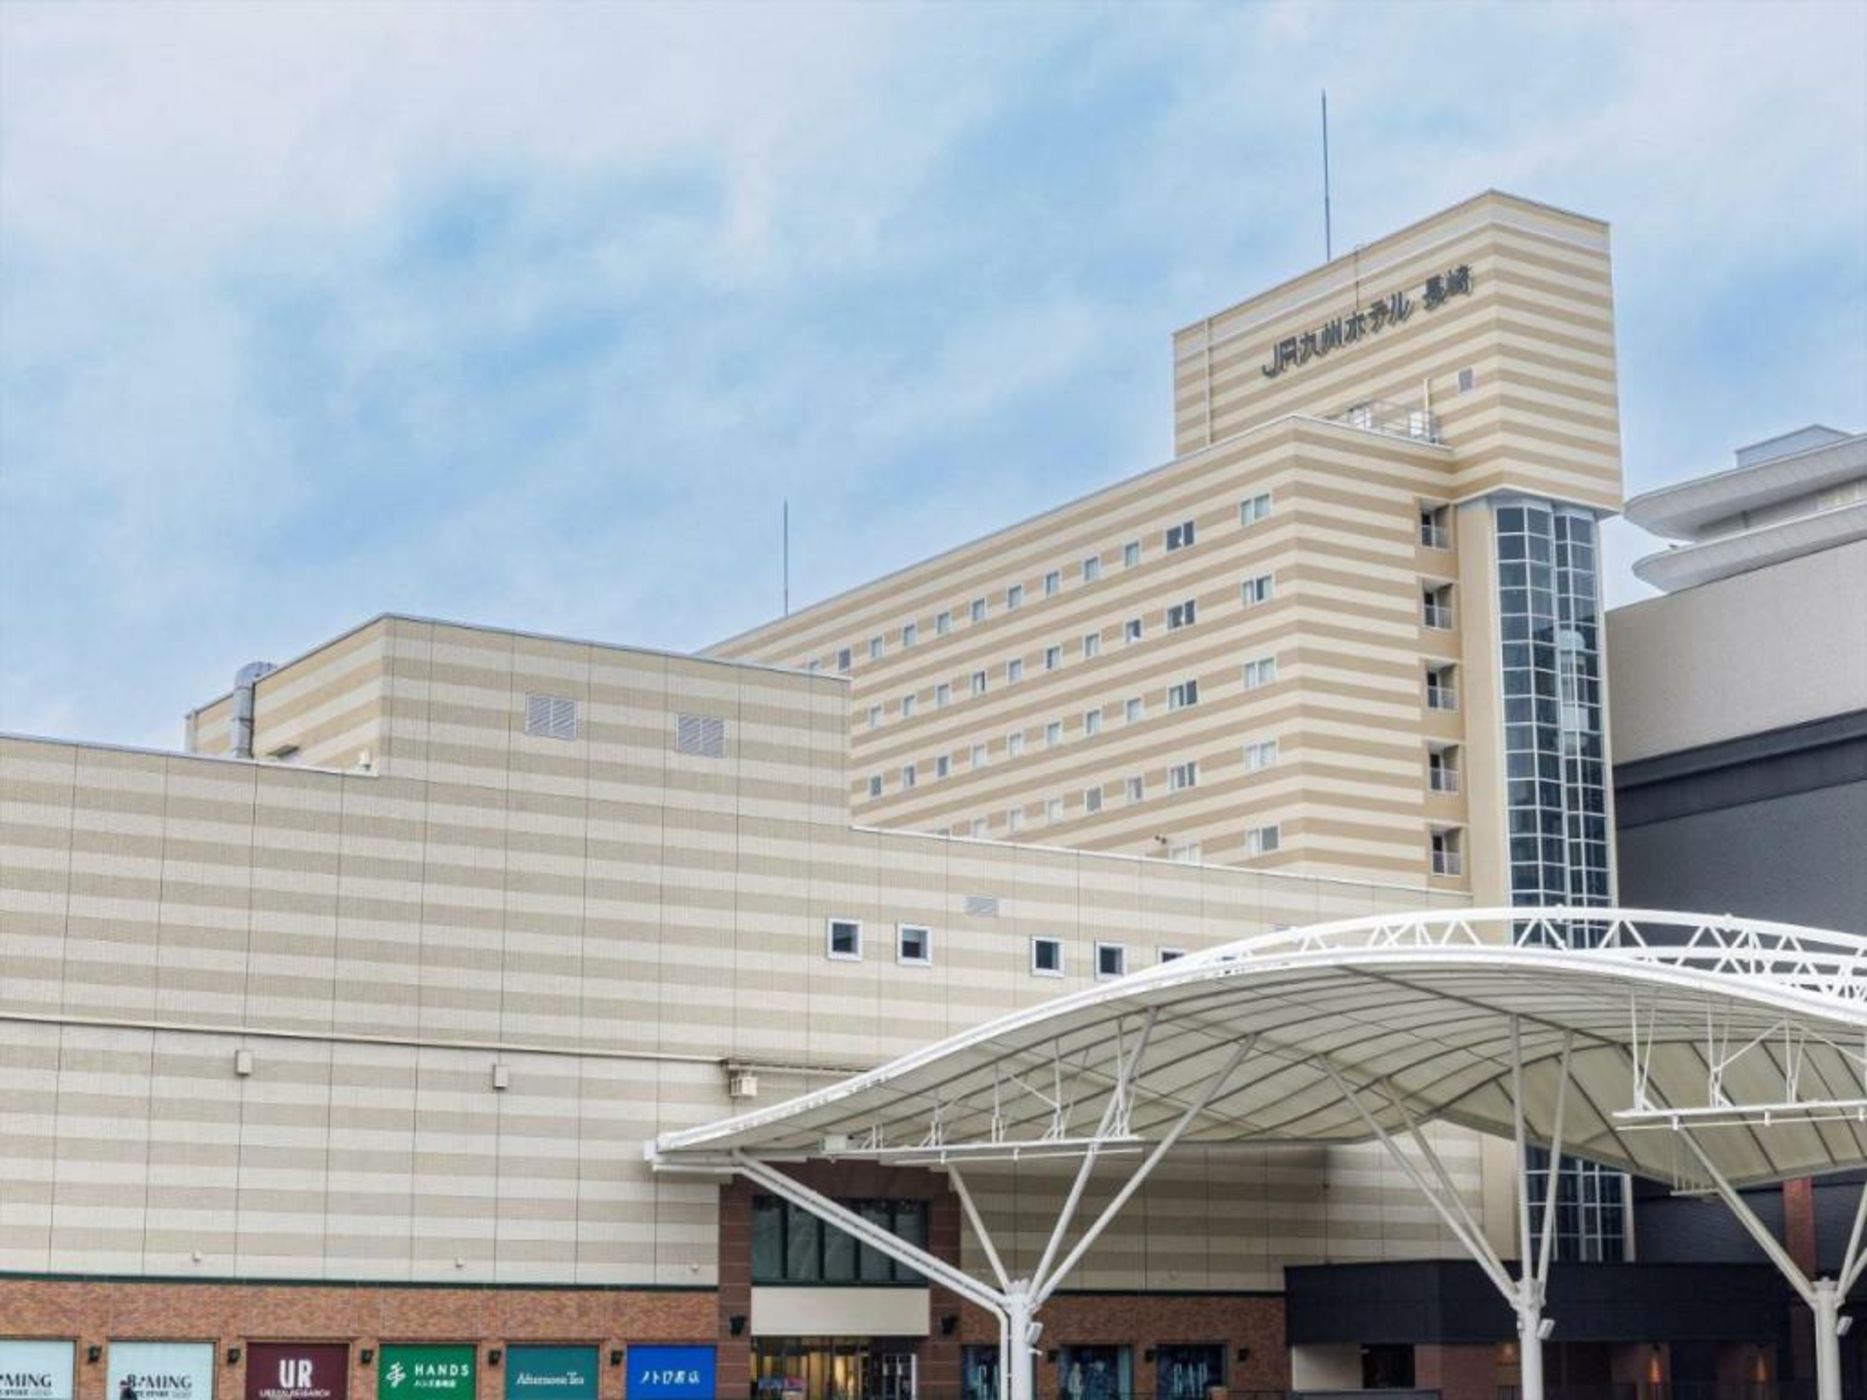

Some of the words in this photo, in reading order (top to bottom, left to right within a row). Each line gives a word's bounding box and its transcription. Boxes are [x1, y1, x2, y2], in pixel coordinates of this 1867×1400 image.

[1261, 291, 1416, 378] JR九州ホテル
[1423, 264, 1474, 312] 長崎
[279, 1359, 313, 1388] UR
[414, 1363, 470, 1377] HANDS
[516, 1371, 567, 1385] Afternoon
[567, 1370, 584, 1385] Tea
[1173, 1363, 1208, 1398] GAP
